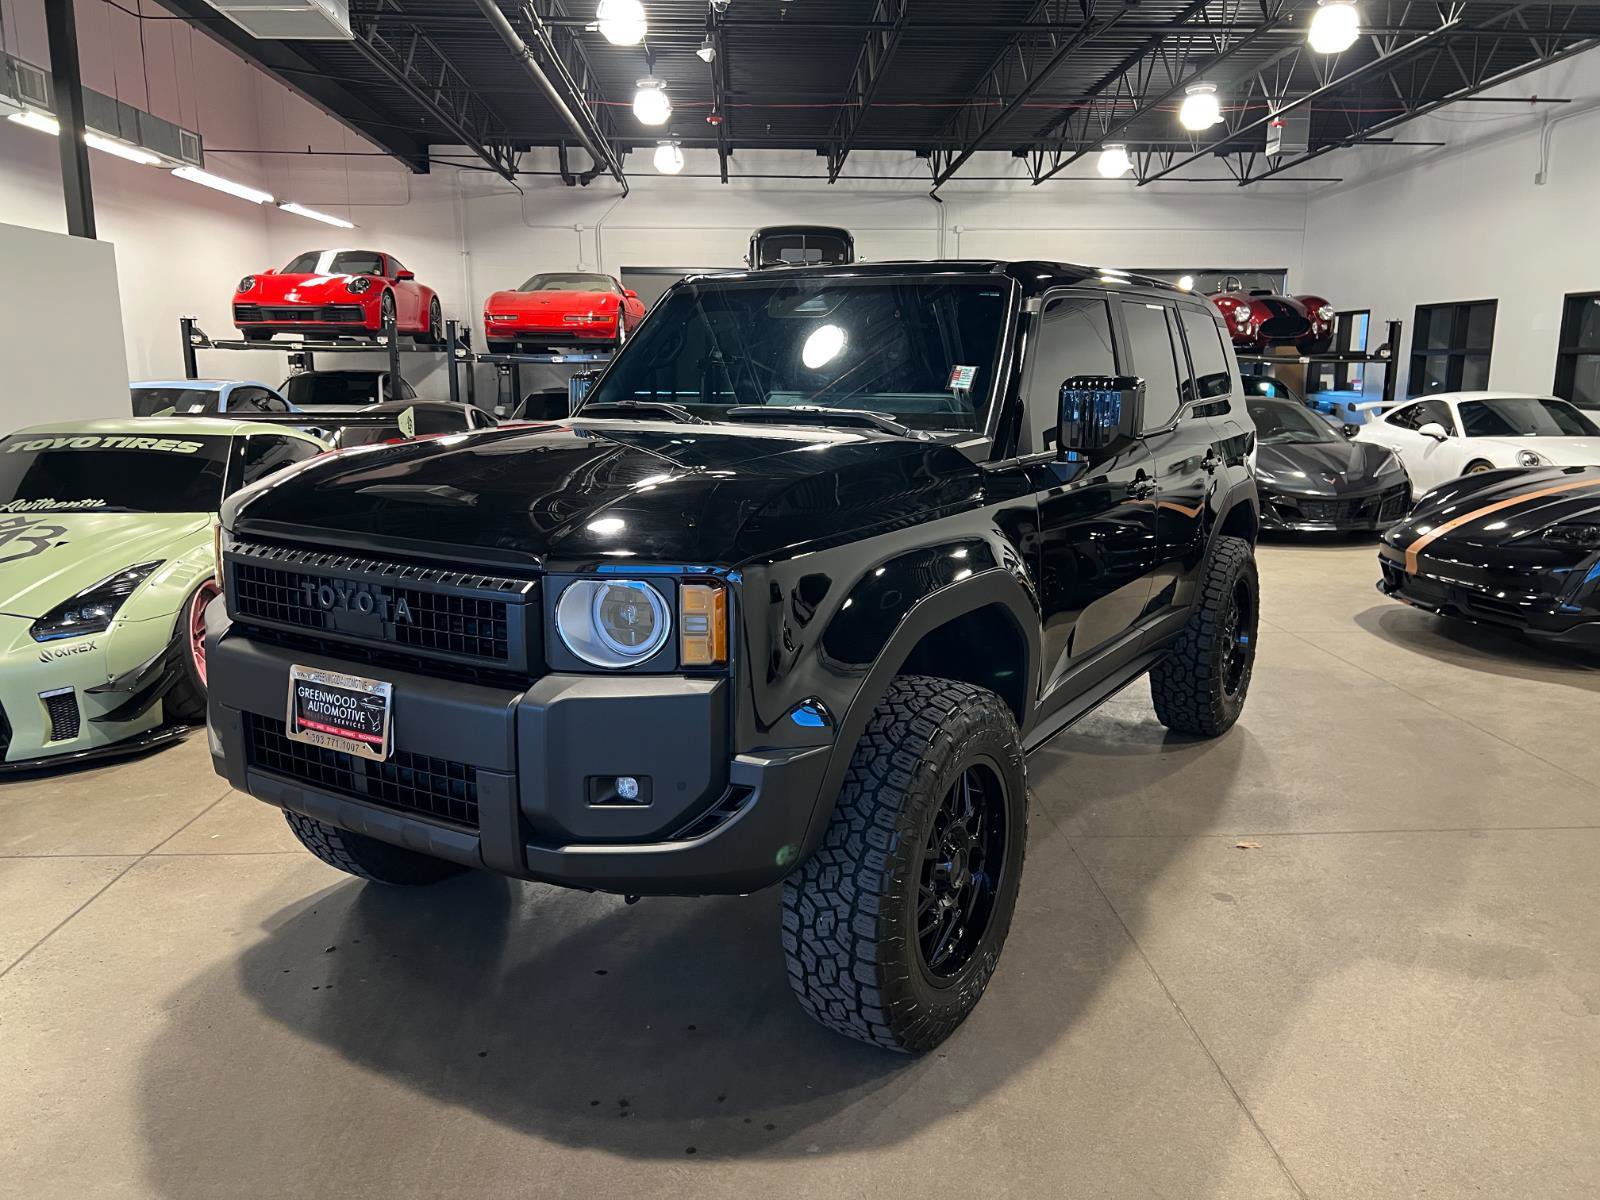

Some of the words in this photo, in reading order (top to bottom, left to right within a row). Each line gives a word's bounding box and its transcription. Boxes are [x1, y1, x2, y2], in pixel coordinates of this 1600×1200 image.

[6, 436, 102, 453] TOYO
[99, 436, 205, 454] TIRES
[301, 582, 413, 624] TOYOTA
[297, 686, 357, 709] GREENWOOD
[307, 700, 366, 723] AUTOMOTIVE
[334, 717, 366, 730] SERVICES
